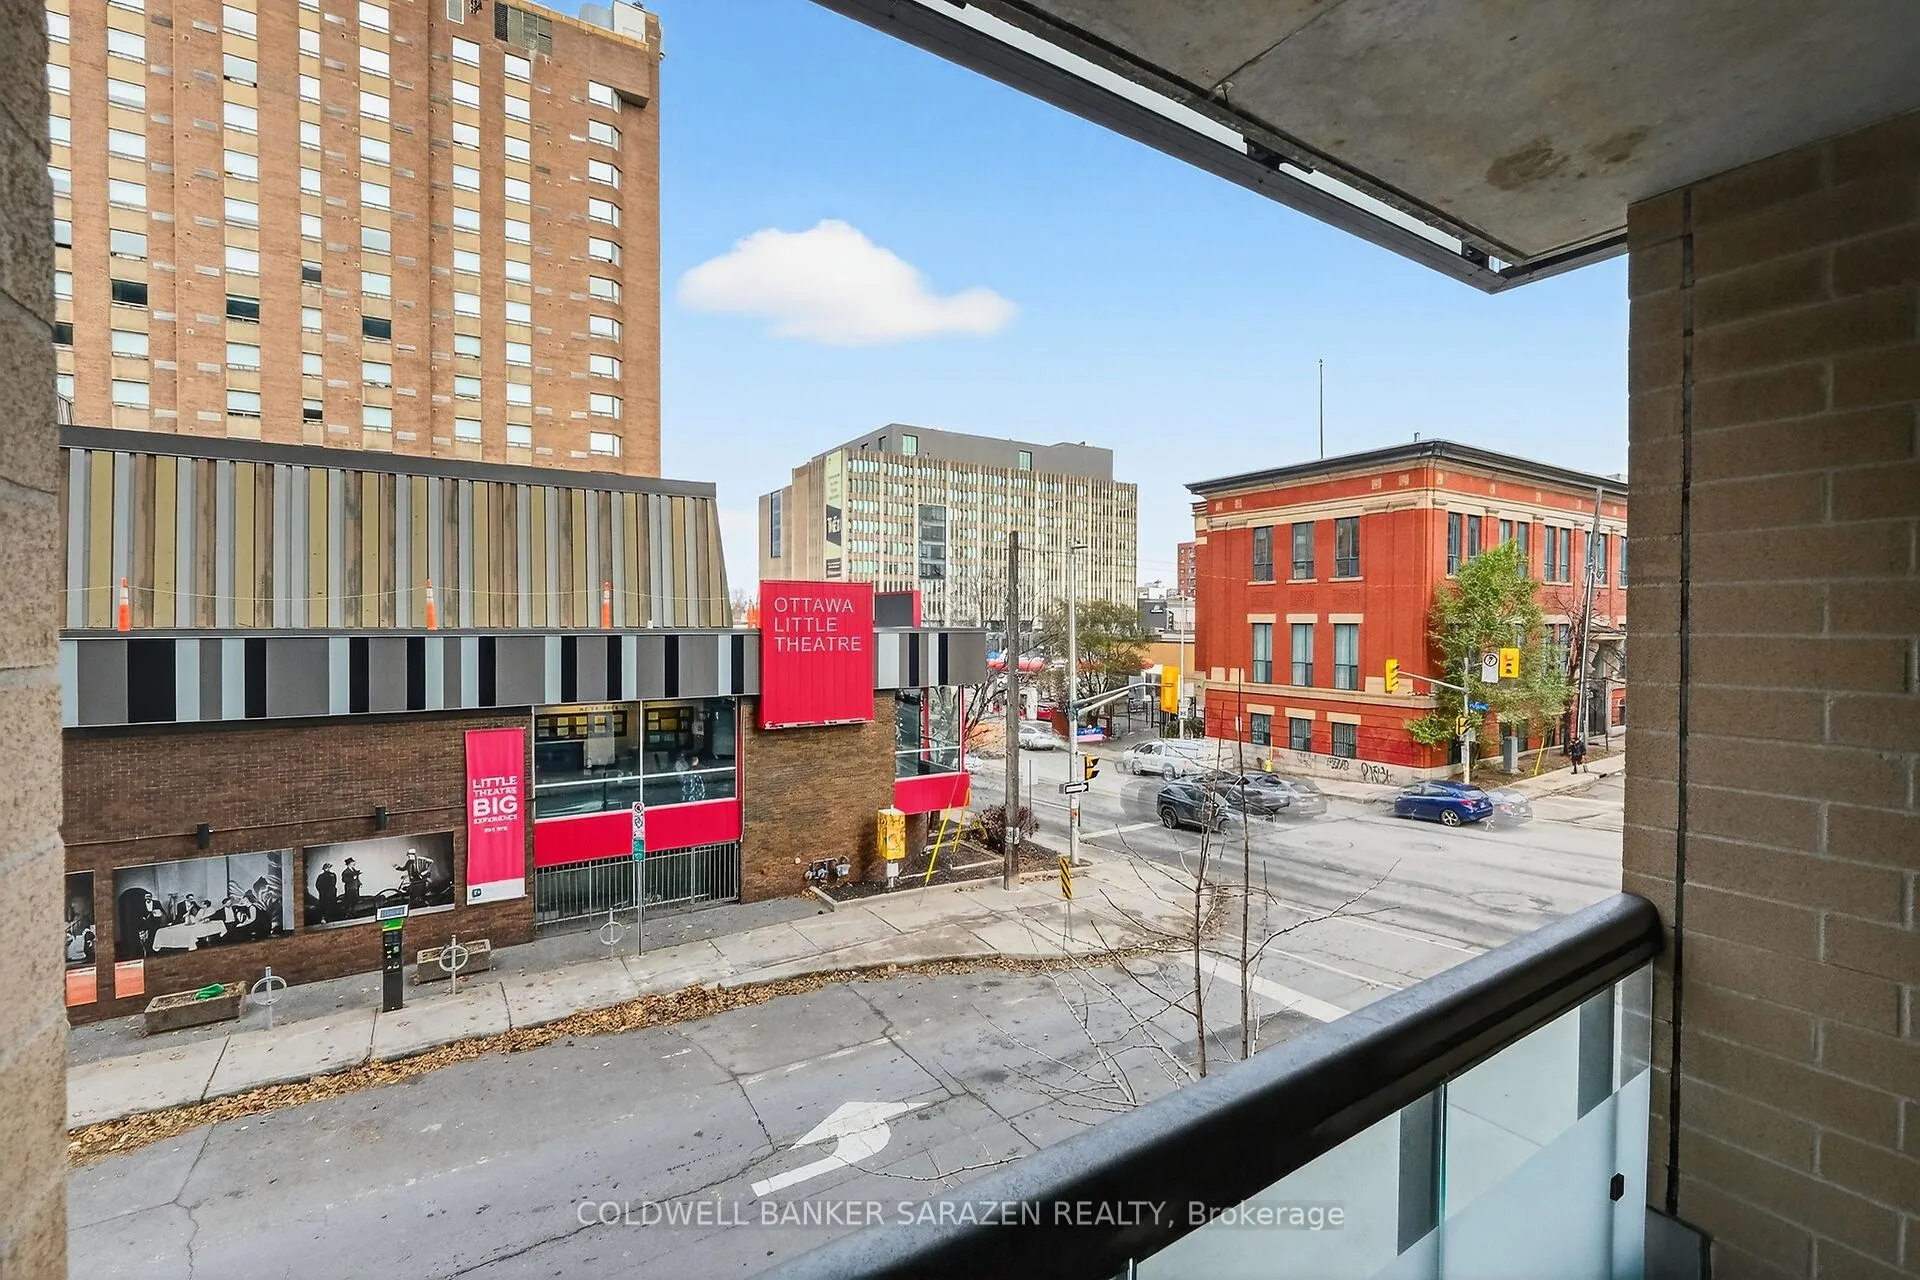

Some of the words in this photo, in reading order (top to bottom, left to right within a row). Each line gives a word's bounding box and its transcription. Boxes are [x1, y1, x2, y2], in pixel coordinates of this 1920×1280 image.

[774, 597, 854, 613] OTTAWA
[774, 617, 837, 632] LITTLE
[774, 636, 862, 652] THEATRE
[472, 775, 518, 789] LITTLE
[473, 794, 518, 818] BIG
